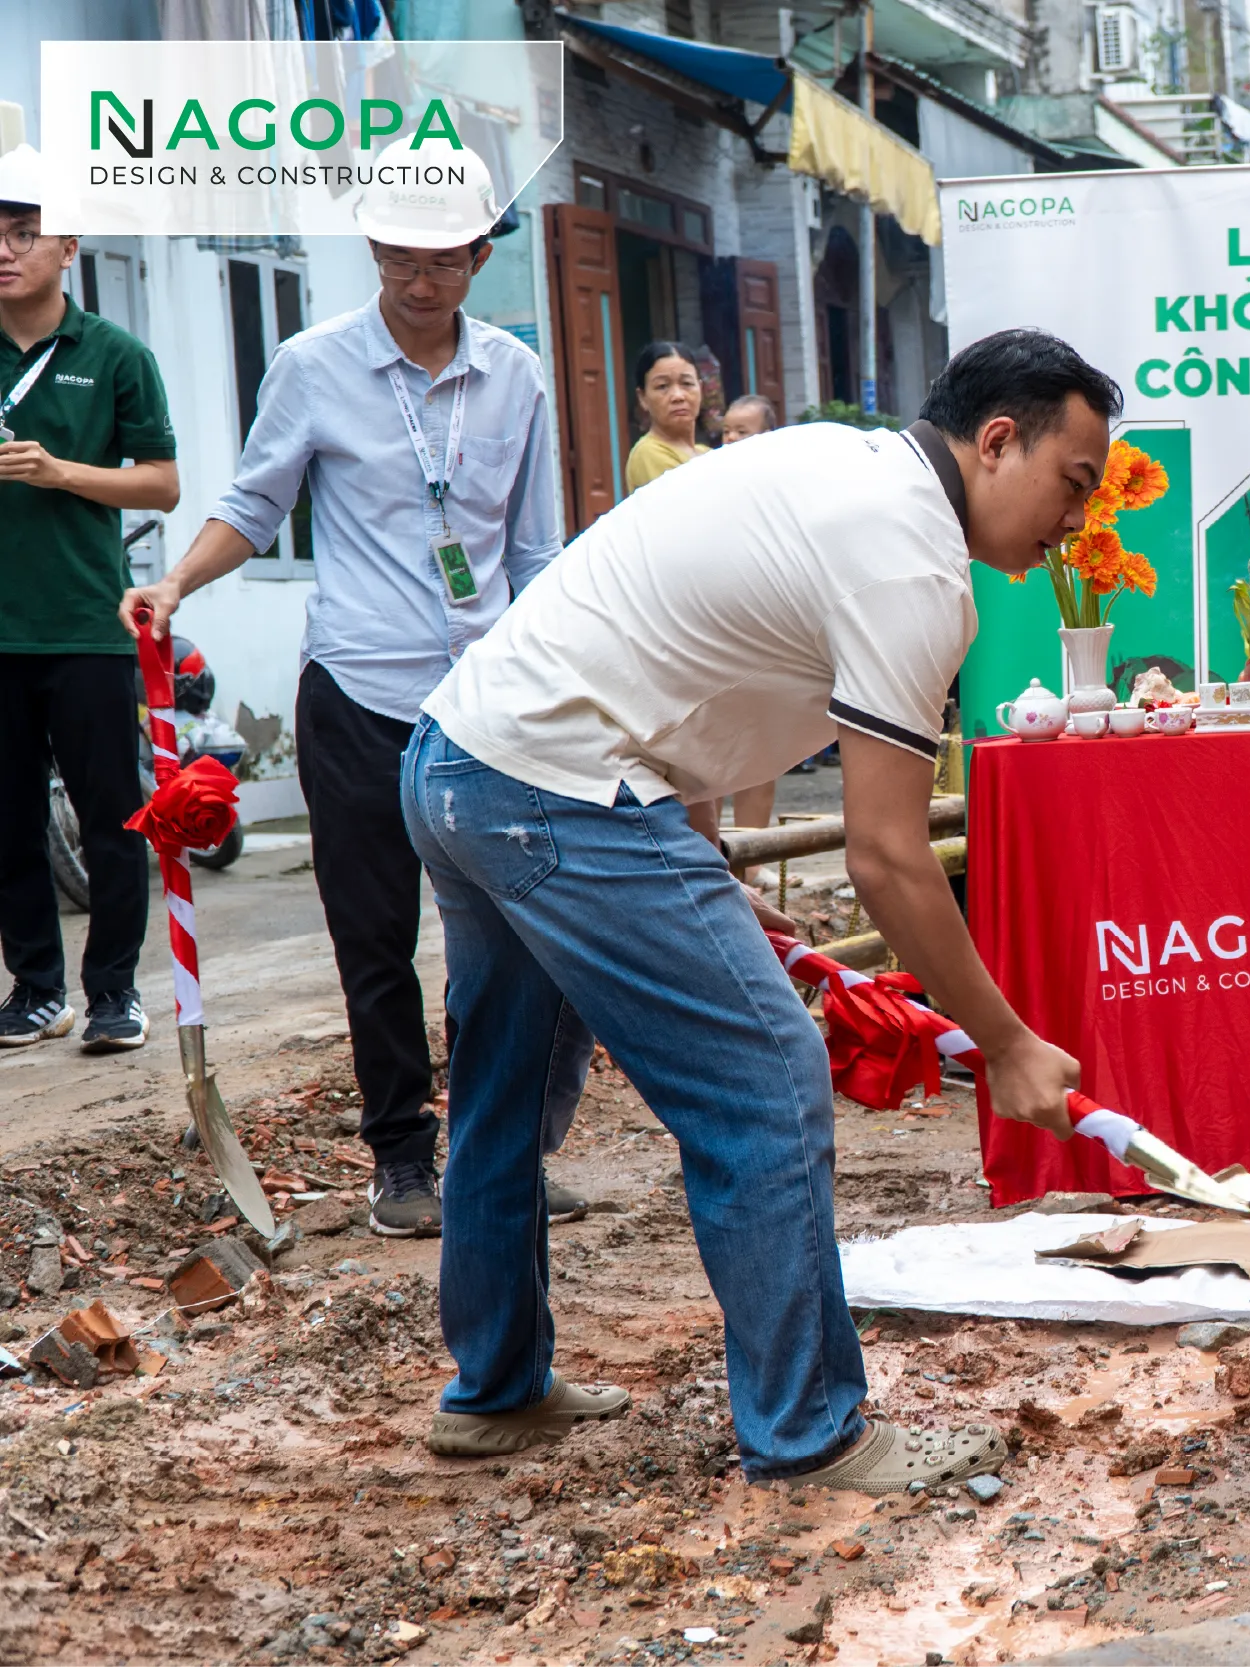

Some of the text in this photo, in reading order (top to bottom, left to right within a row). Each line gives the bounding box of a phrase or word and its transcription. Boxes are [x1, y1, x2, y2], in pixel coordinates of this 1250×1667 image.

[958, 197, 1075, 222] NAGOPA
[959, 223, 992, 233] DESIGN
[1003, 219, 1076, 230] CONSTRUCTION
[55, 373, 94, 384] NAGOPA
[1102, 976, 1187, 1001] DESIGN
[1196, 974, 1210, 991] &
